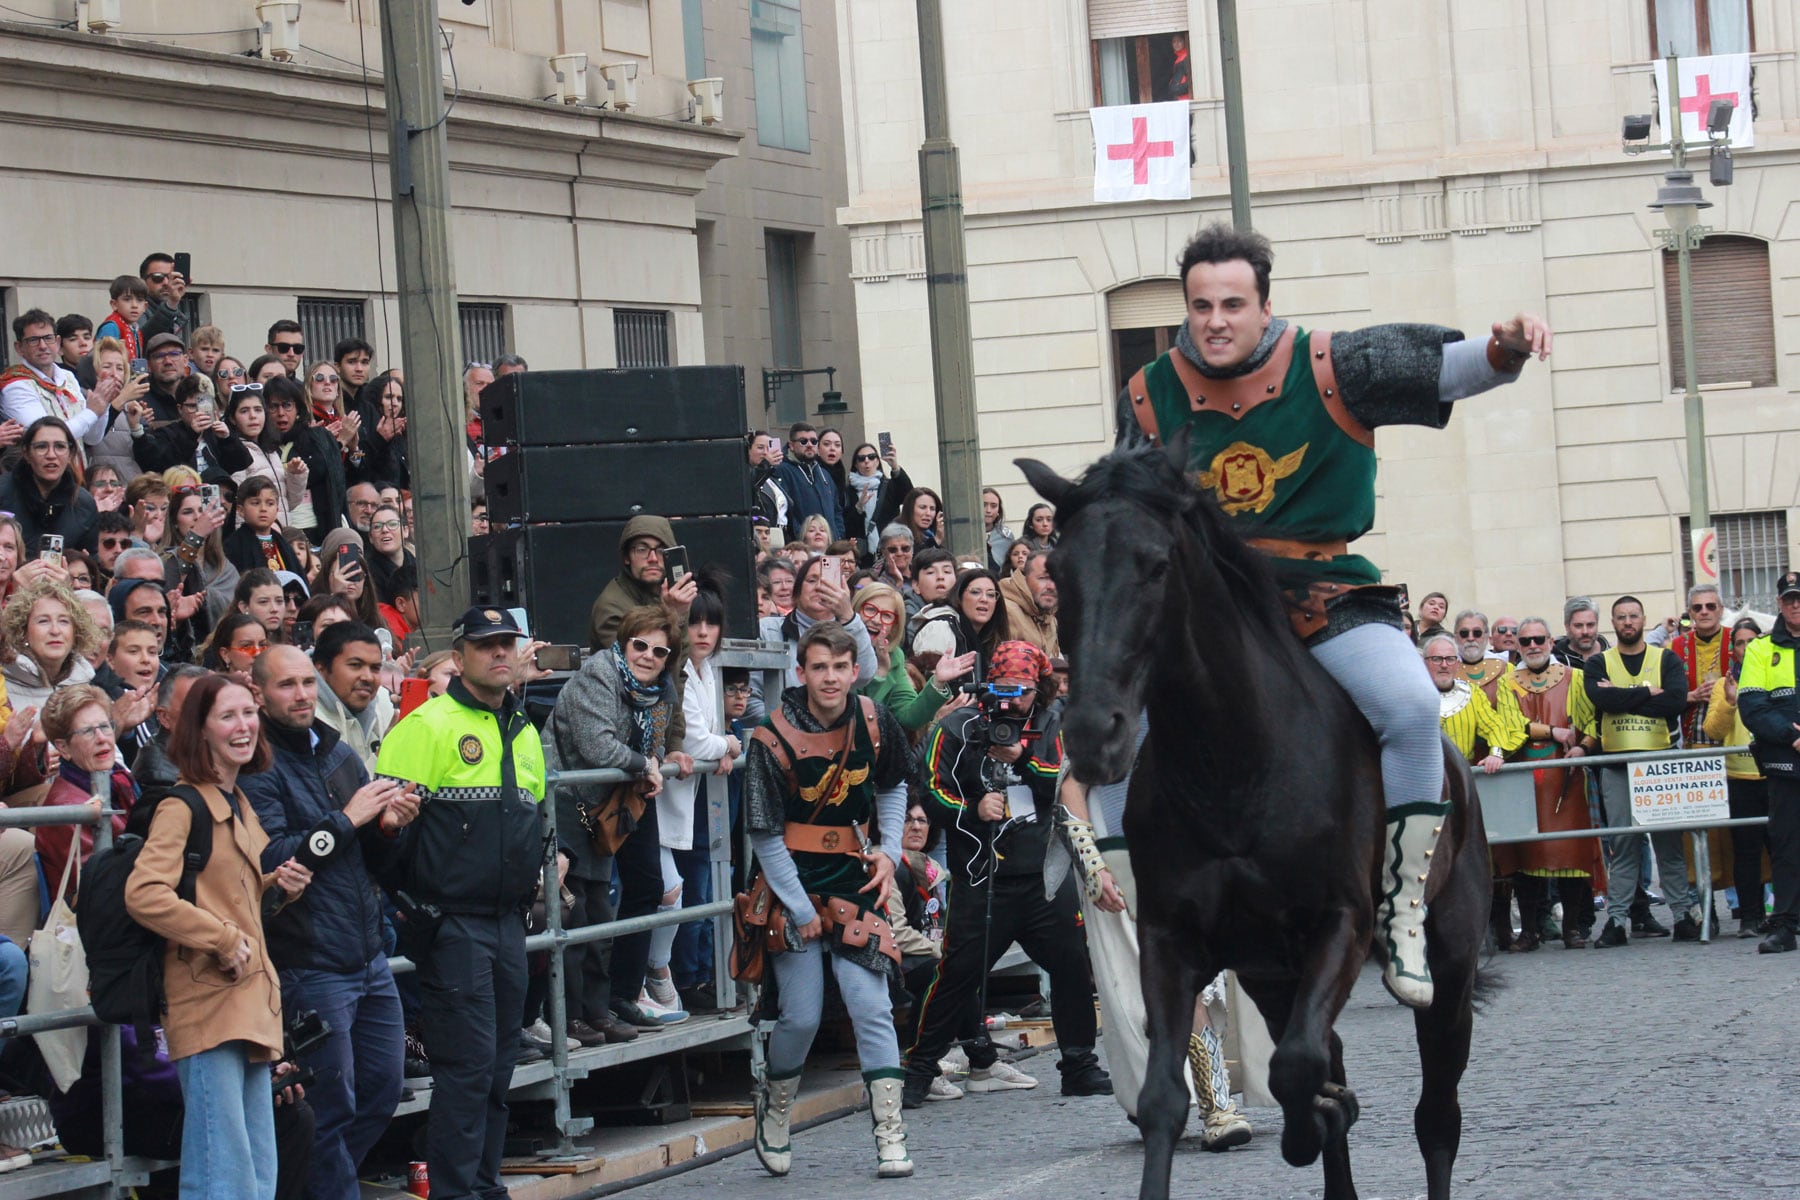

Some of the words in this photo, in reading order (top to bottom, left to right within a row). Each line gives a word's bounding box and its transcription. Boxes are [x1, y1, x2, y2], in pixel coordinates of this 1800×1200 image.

[1646, 759, 1722, 777] ALSETRANS
[1634, 780, 1723, 793] MAQUINARIA
[1635, 795, 1652, 807] 96
[1656, 792, 1681, 805] 291
[1687, 790, 1704, 803] 08
[1708, 788, 1725, 801] 41
